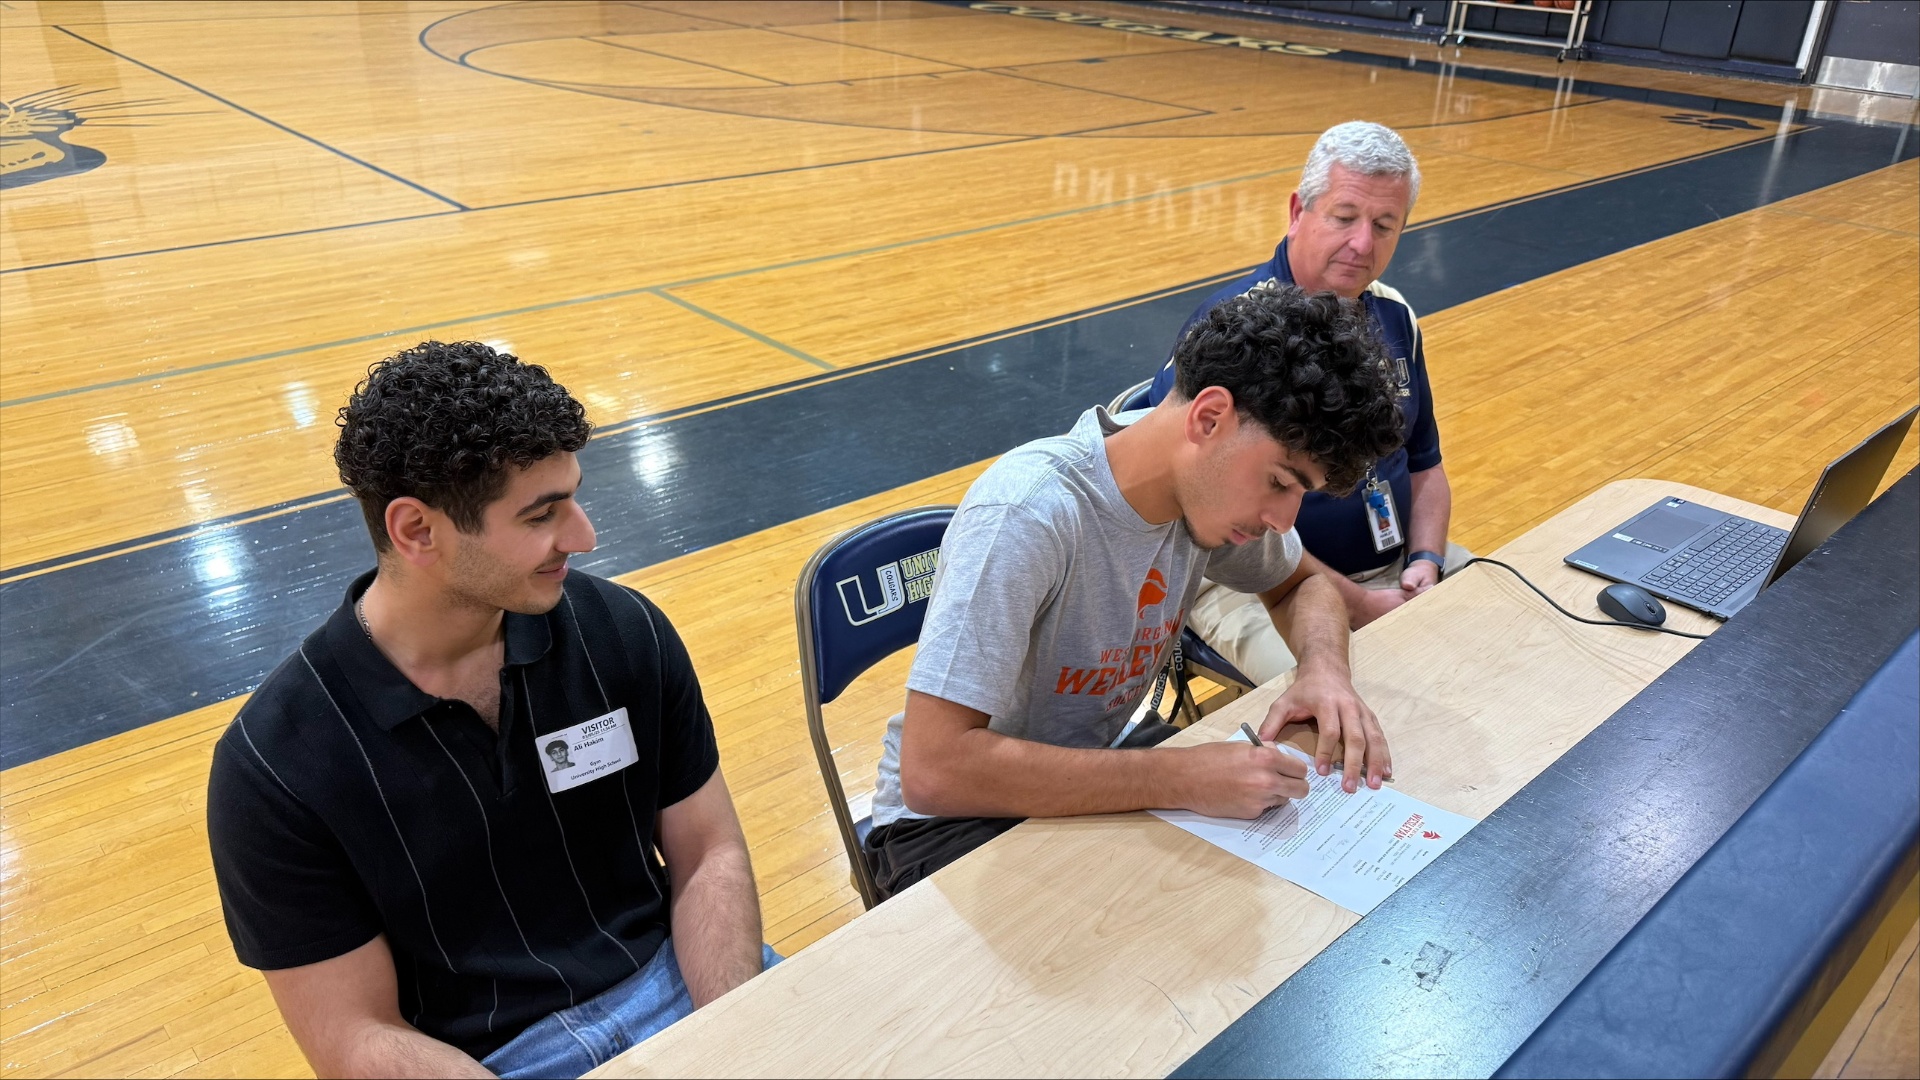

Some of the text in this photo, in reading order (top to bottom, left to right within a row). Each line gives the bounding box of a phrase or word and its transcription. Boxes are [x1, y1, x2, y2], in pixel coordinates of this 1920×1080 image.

[969, 3, 1341, 56] COUGARS
[885, 570, 898, 602] COUGARS
[581, 717, 615, 734] VISITOR
[584, 737, 604, 748] Hakim
[571, 758, 622, 780] University High School
[590, 759, 602, 767] Gym
[1393, 812, 1424, 841] WESLEYAN
